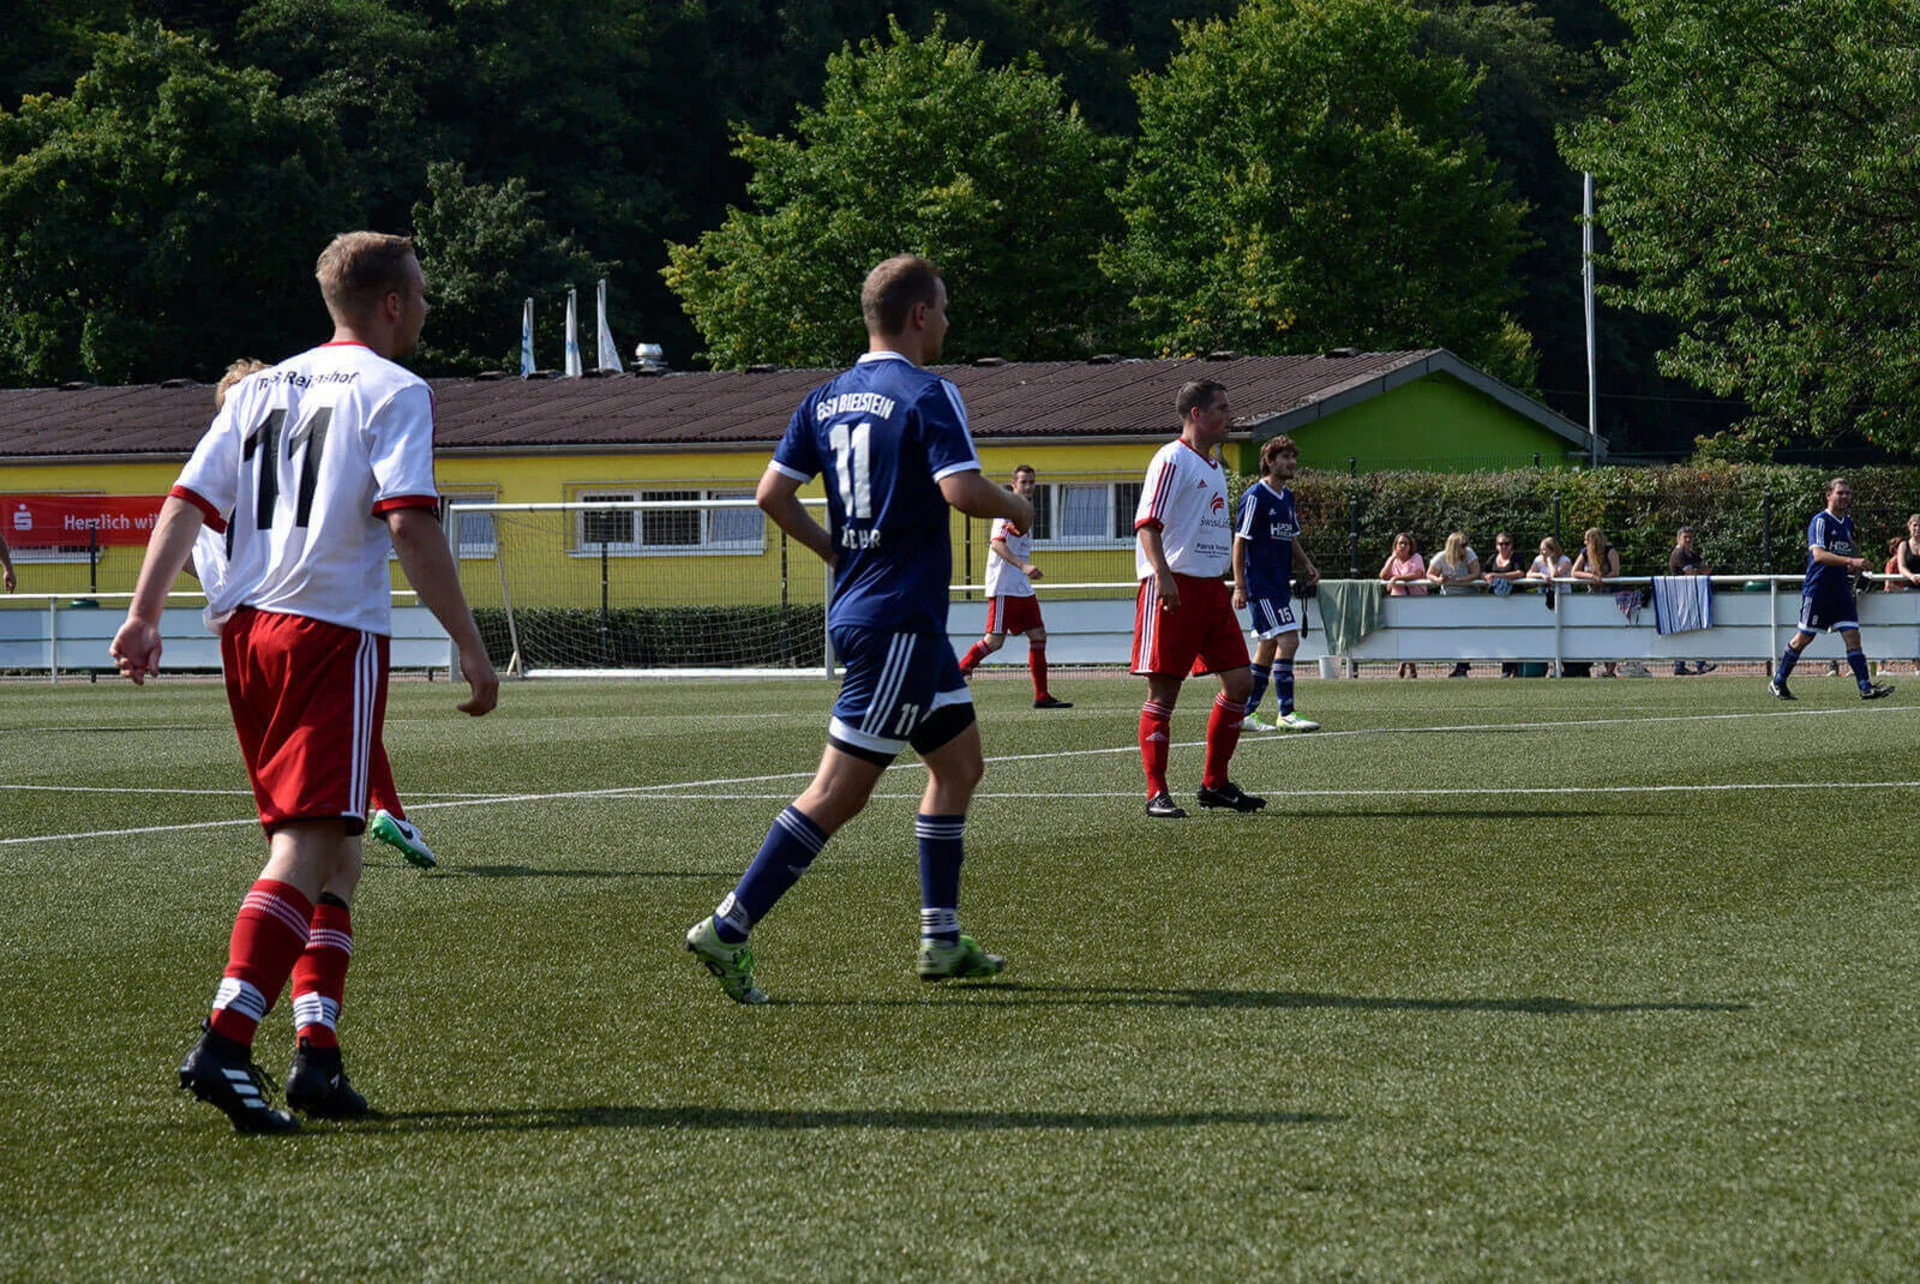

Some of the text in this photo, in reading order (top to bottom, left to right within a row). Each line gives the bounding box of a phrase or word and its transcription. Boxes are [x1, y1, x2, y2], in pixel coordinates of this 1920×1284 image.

[839, 392, 895, 420] BIELSTEIN
[243, 407, 334, 530] 11
[829, 423, 872, 519] 11
[64, 513, 130, 531] Herzlich
[1278, 607, 1292, 623] 15
[894, 703, 920, 736] 11
